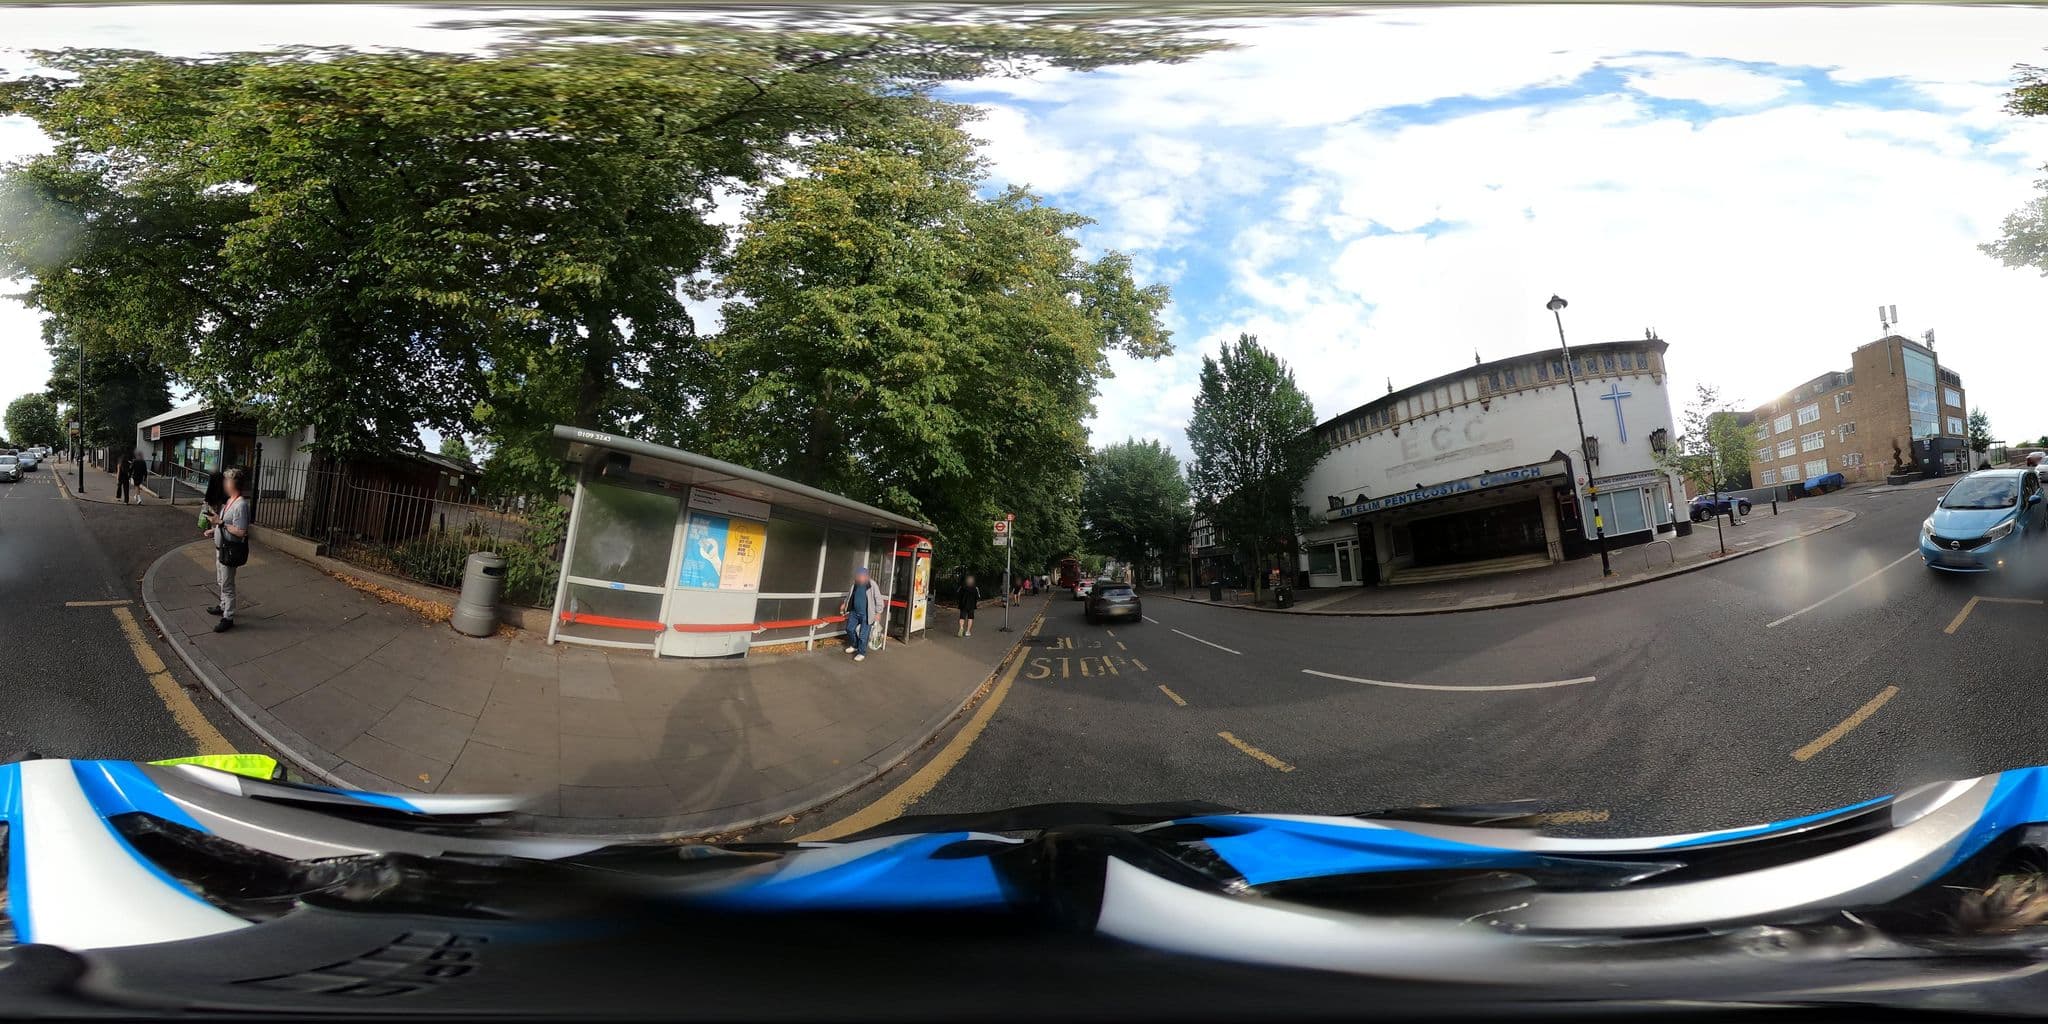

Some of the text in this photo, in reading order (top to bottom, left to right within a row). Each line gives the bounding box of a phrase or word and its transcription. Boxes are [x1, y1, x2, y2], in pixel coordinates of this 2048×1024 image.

[1401, 418, 1485, 461] ECC
[1340, 467, 1540, 517] AN ELIM PENTECOSTAL CURCH
[1612, 475, 1637, 483] CHRISTIAN
[1024, 655, 1127, 680] STOP
